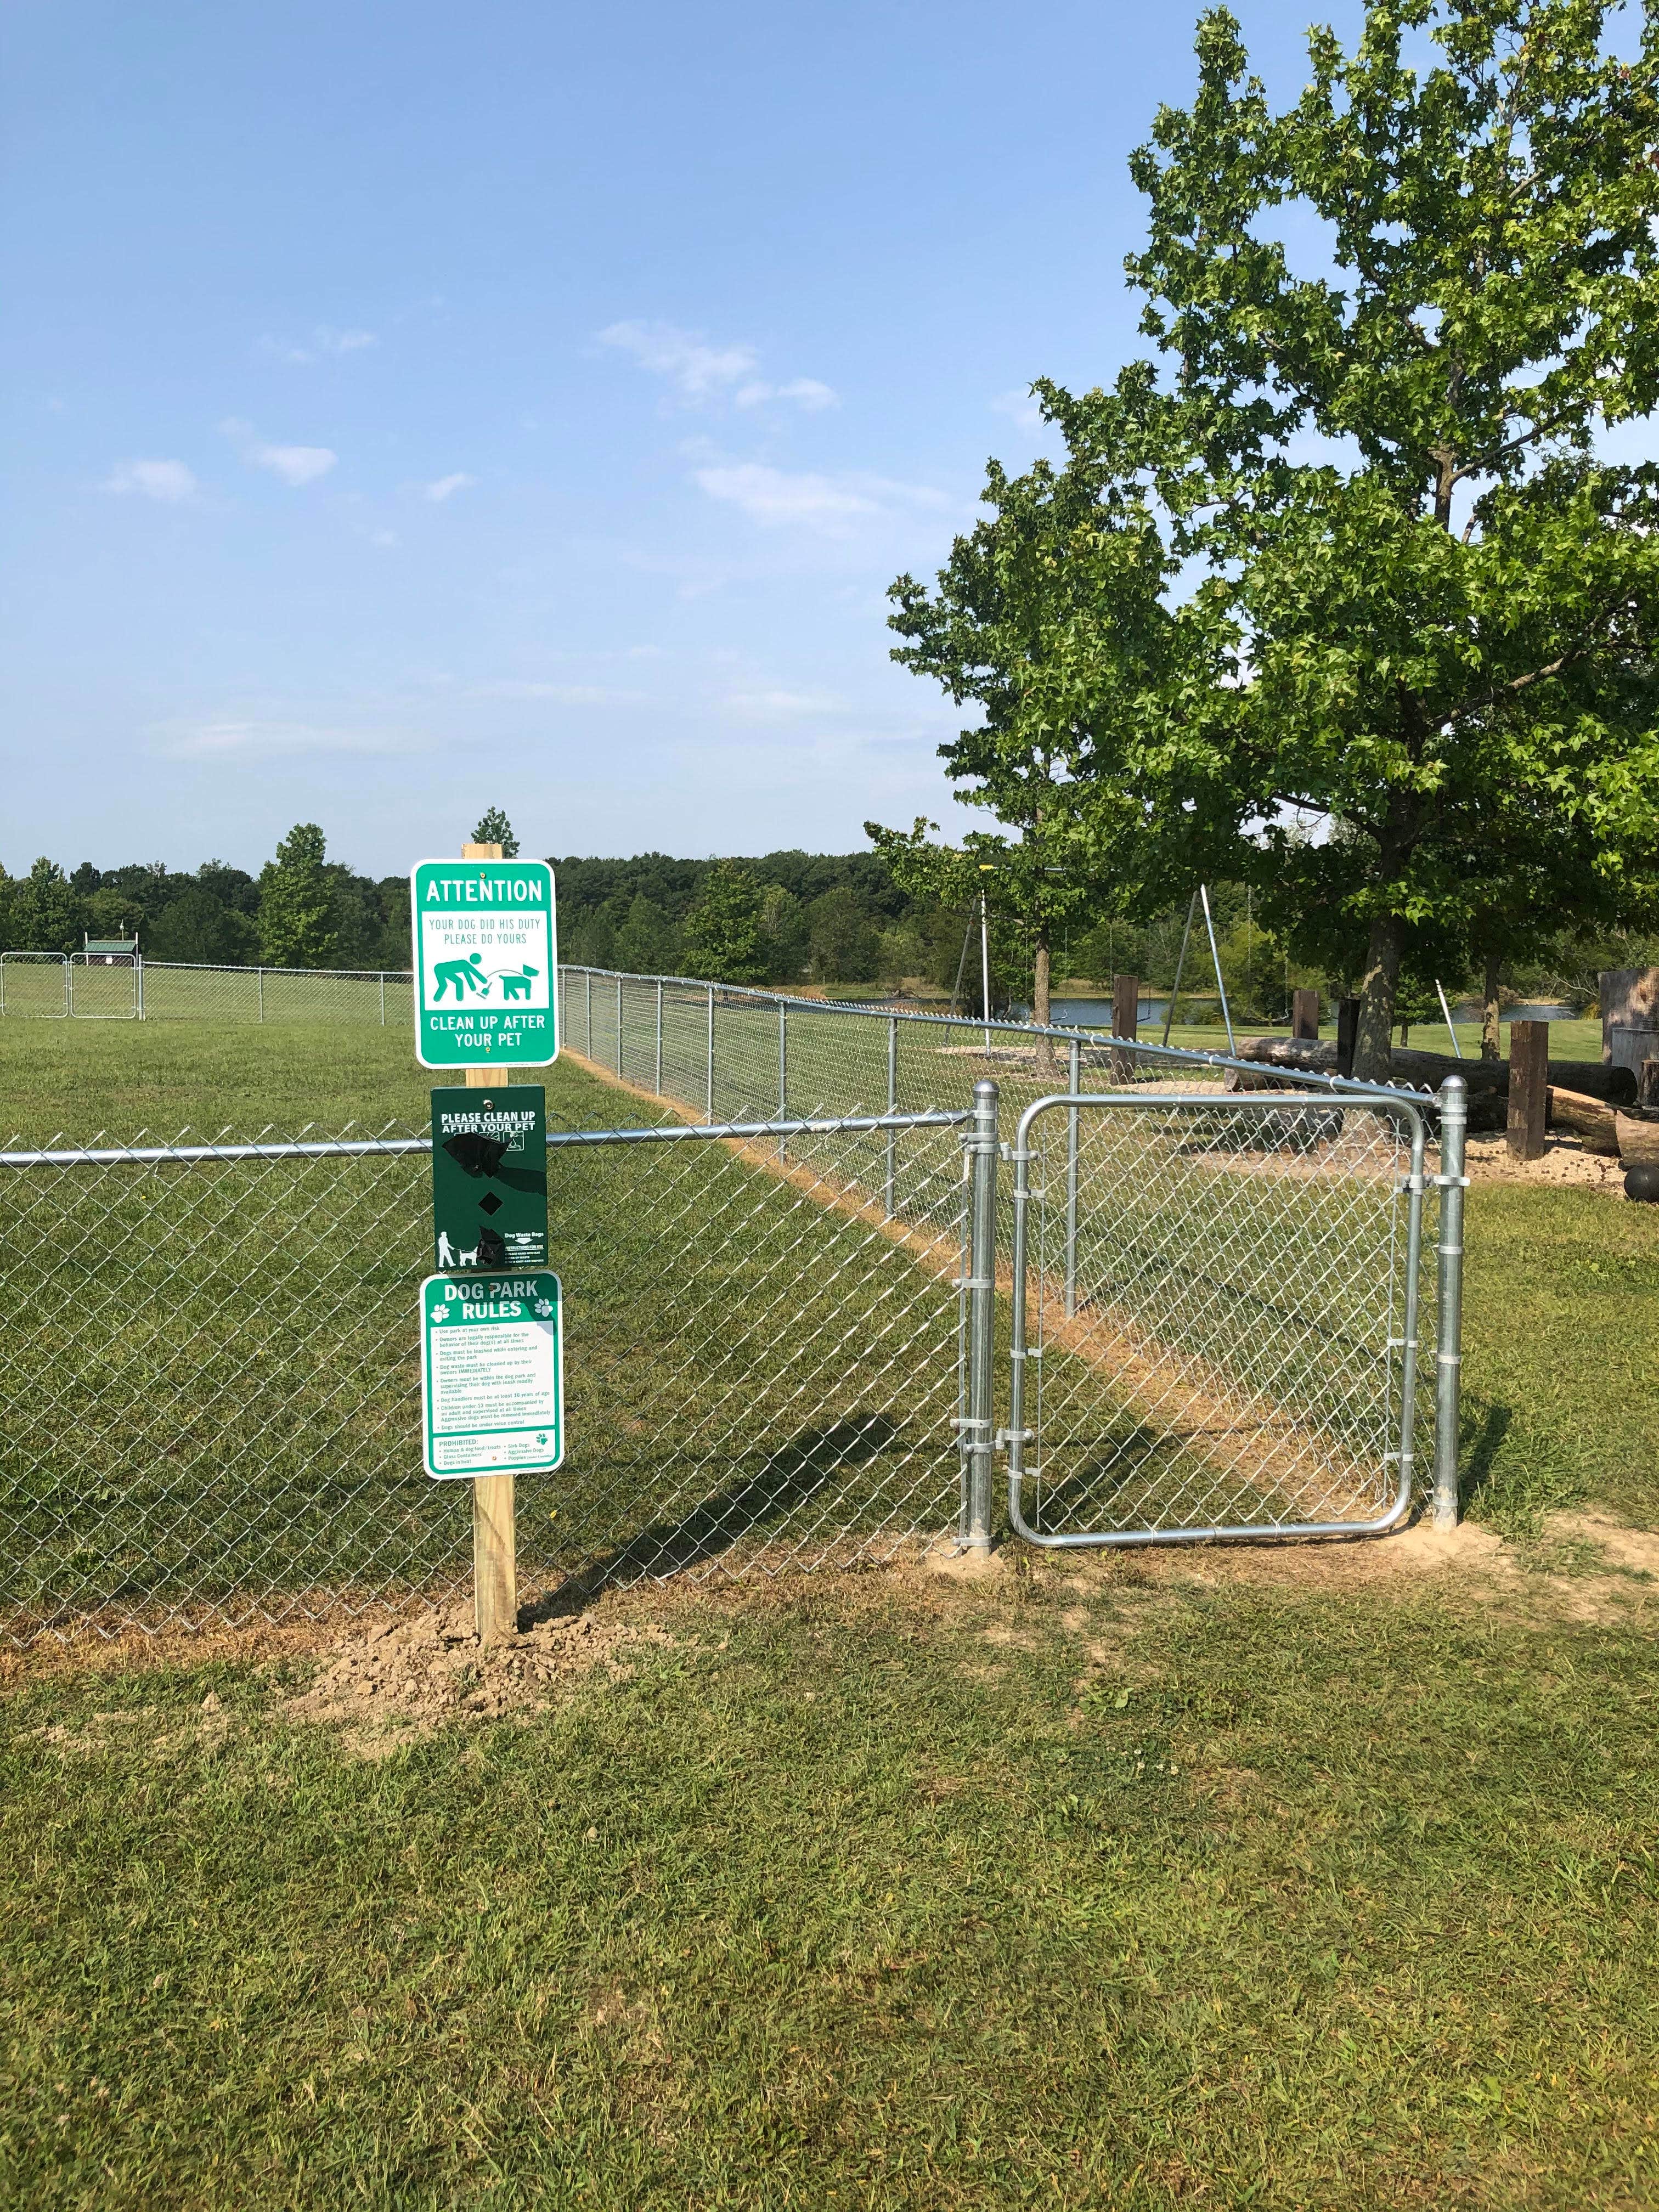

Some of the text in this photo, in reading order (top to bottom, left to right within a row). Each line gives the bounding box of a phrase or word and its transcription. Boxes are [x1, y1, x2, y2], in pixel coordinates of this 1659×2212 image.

[426, 879, 542, 902] ATTENTION
[429, 918, 540, 929] YOUR DOG DID HIS DUTY
[444, 934, 526, 944] PLEASE DO YOURS
[430, 1015, 545, 1031] CLEAN UP AFTER
[455, 1032, 522, 1047] YOUR PET
[441, 1111, 535, 1123] PLEASE CLEAN UP
[442, 1122, 535, 1133] AFTER YOUR PET
[445, 1280, 538, 1301] DOG PARK
[462, 1300, 521, 1319] RULES
